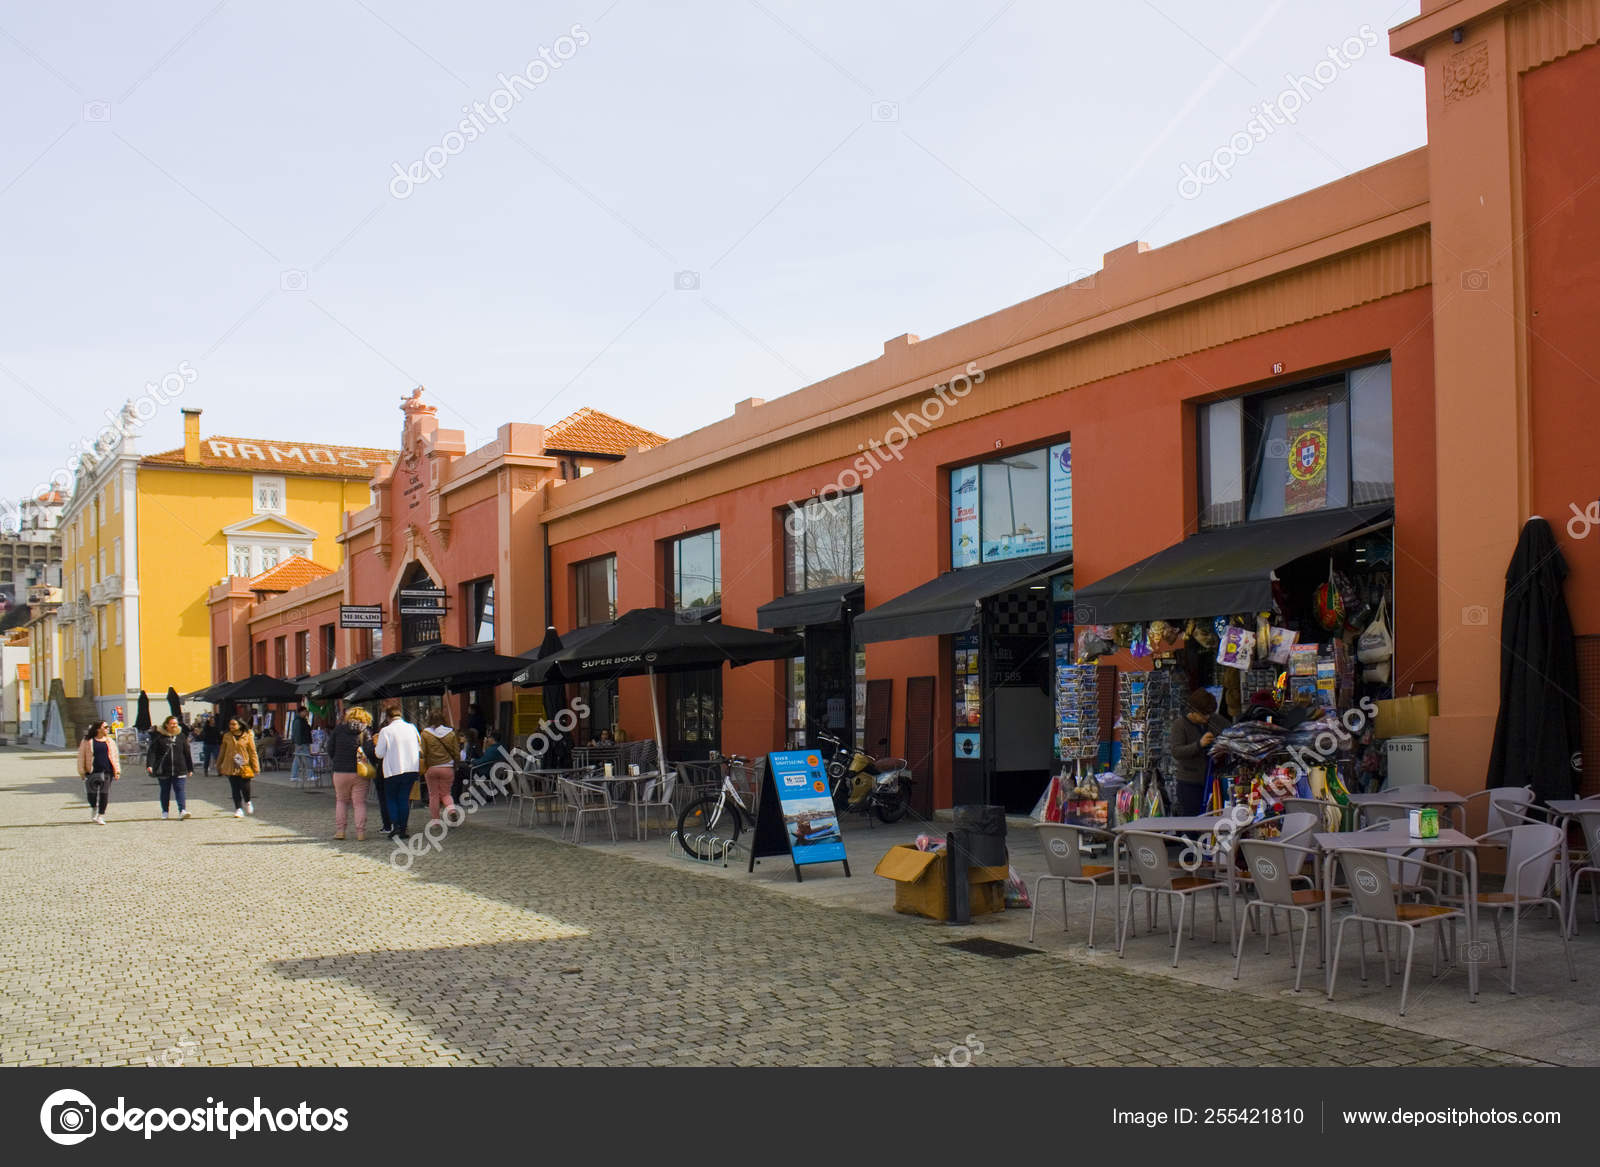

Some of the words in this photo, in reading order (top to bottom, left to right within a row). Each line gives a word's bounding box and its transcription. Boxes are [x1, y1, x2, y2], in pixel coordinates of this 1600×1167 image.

[1273, 362, 1282, 374] 16
[343, 612, 380, 621] MERCADO
[581, 658, 612, 669] SUPER
[614, 655, 642, 664] BOCK
